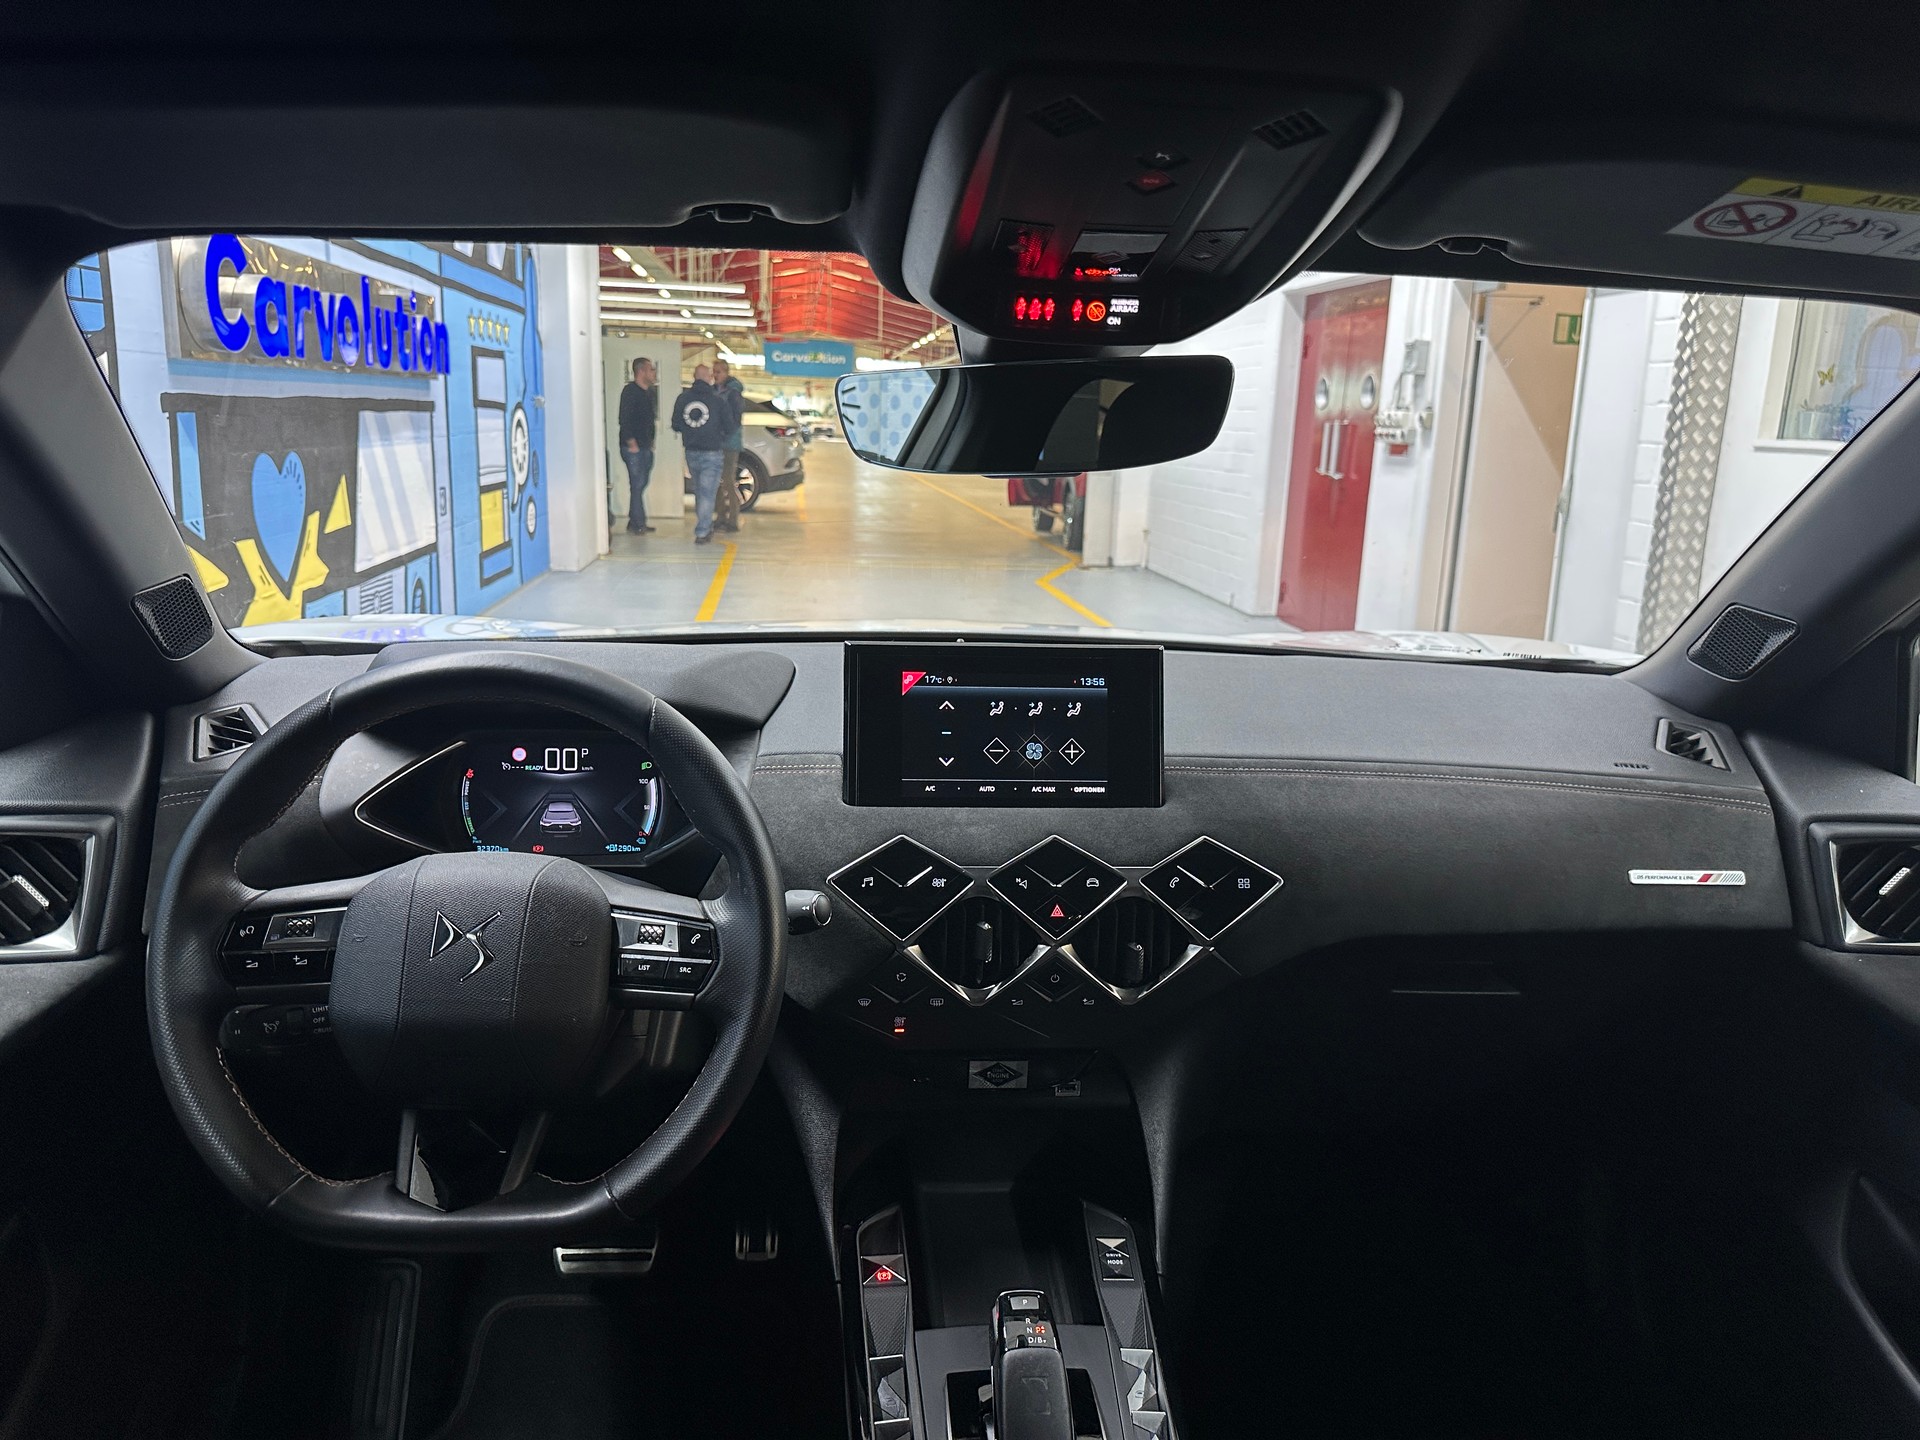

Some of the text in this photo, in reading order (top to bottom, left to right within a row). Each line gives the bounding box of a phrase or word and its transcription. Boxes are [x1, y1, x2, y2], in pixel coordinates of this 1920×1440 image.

[204, 234, 451, 375] Carvolution
[1109, 305, 1139, 313] AIRBAG
[1106, 316, 1121, 325] ON
[1080, 677, 1105, 686] 13:56
[581, 748, 589, 759] P
[544, 747, 578, 771] 00
[637, 963, 651, 971] LIST
[679, 966, 692, 974] SRC
[312, 1016, 326, 1024] OFF
[313, 1026, 332, 1034] CRUIS
[1025, 1317, 1032, 1325] R
[1027, 1336, 1043, 1344] D/B
